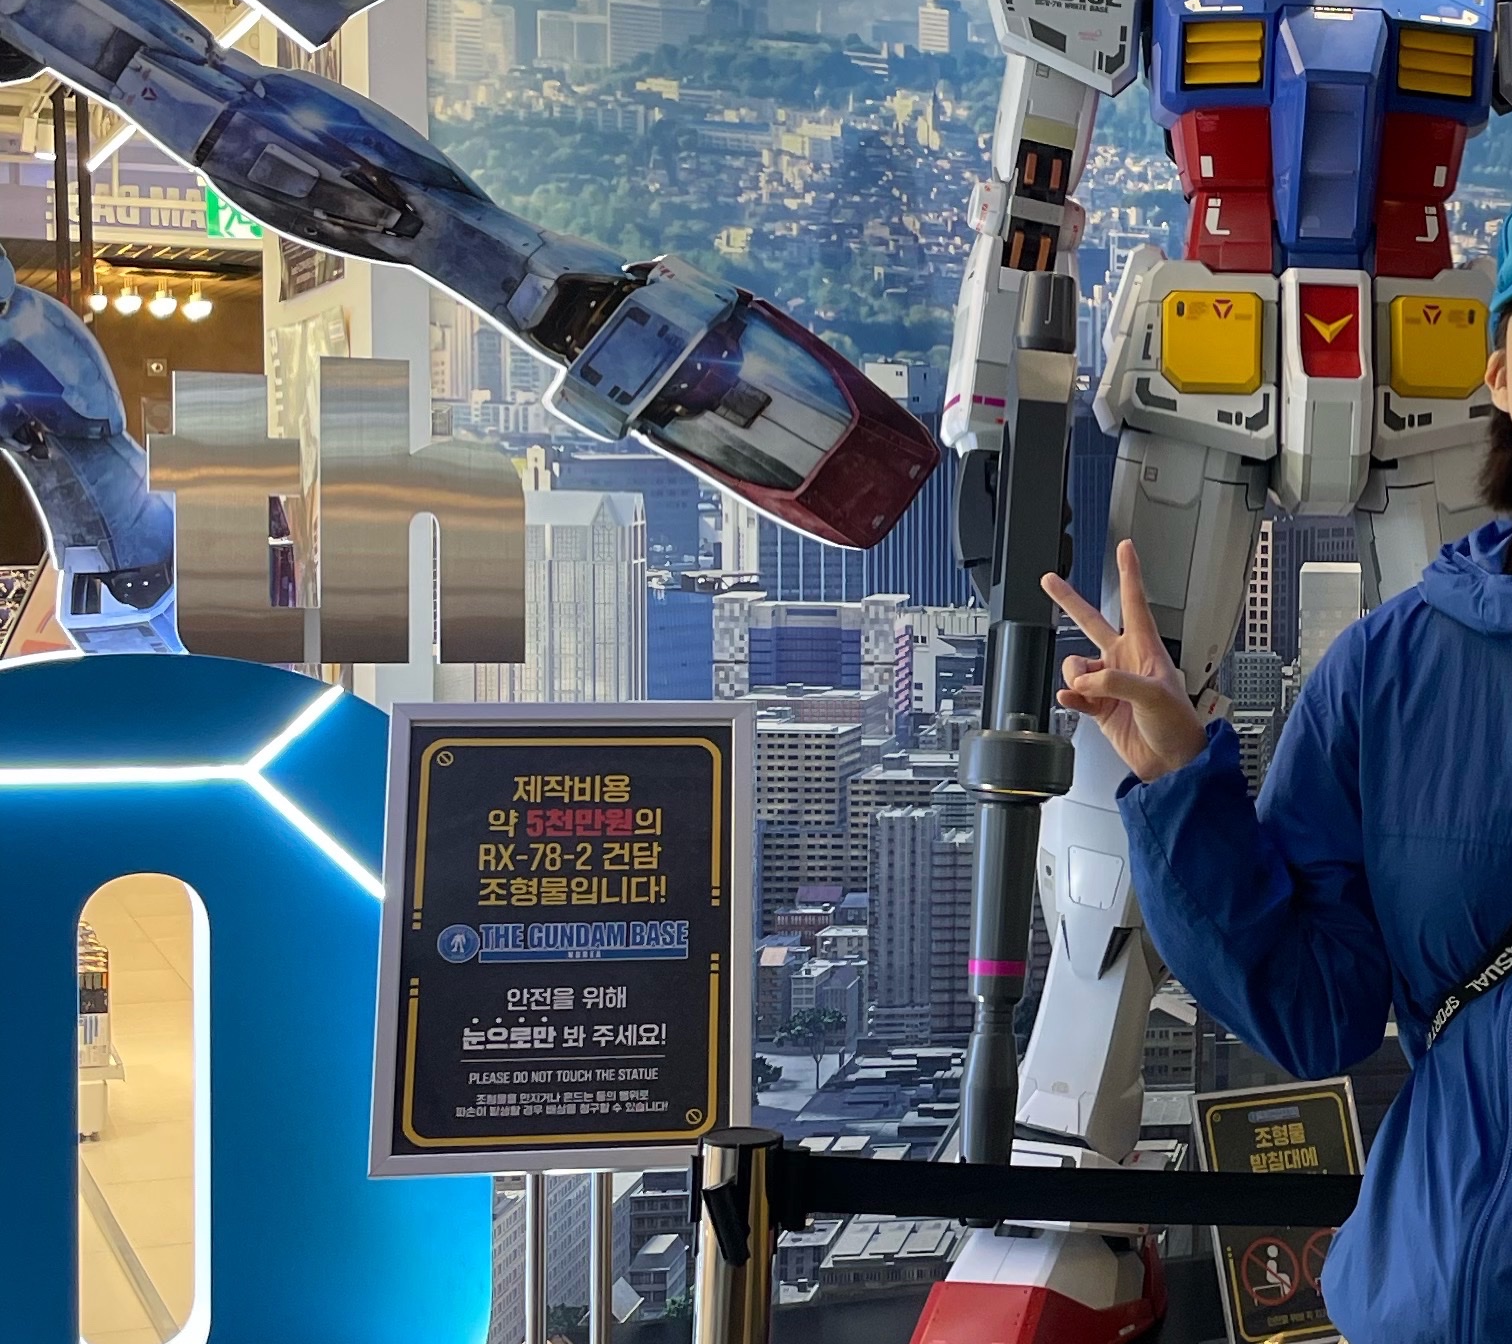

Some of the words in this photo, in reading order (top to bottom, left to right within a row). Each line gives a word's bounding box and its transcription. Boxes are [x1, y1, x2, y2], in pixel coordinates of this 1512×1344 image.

[512, 774, 631, 803] 제작비용
[488, 809, 520, 838] 약
[525, 807, 662, 837] 5천만원의
[478, 842, 593, 871] RX-78-2
[602, 841, 662, 870] 건담
[478, 875, 667, 906] 조형물입니다!
[479, 923, 525, 950] THE
[527, 921, 628, 949] GUNDAM
[629, 920, 689, 948] BASE
[506, 987, 575, 1011] 안전을
[582, 986, 627, 1009] 위해
[463, 1025, 557, 1050] 눈으로만
[562, 1025, 587, 1048] 봐
[592, 1023, 667, 1047] 주세요!
[468, 1071, 511, 1085] PLEASE
[513, 1070, 529, 1083] DO
[531, 1070, 552, 1083] NOT
[556, 1069, 593, 1082] TOUCH
[596, 1068, 615, 1081] THE
[617, 1068, 659, 1081] STATUE
[1250, 1145, 1319, 1174] 받침대에
